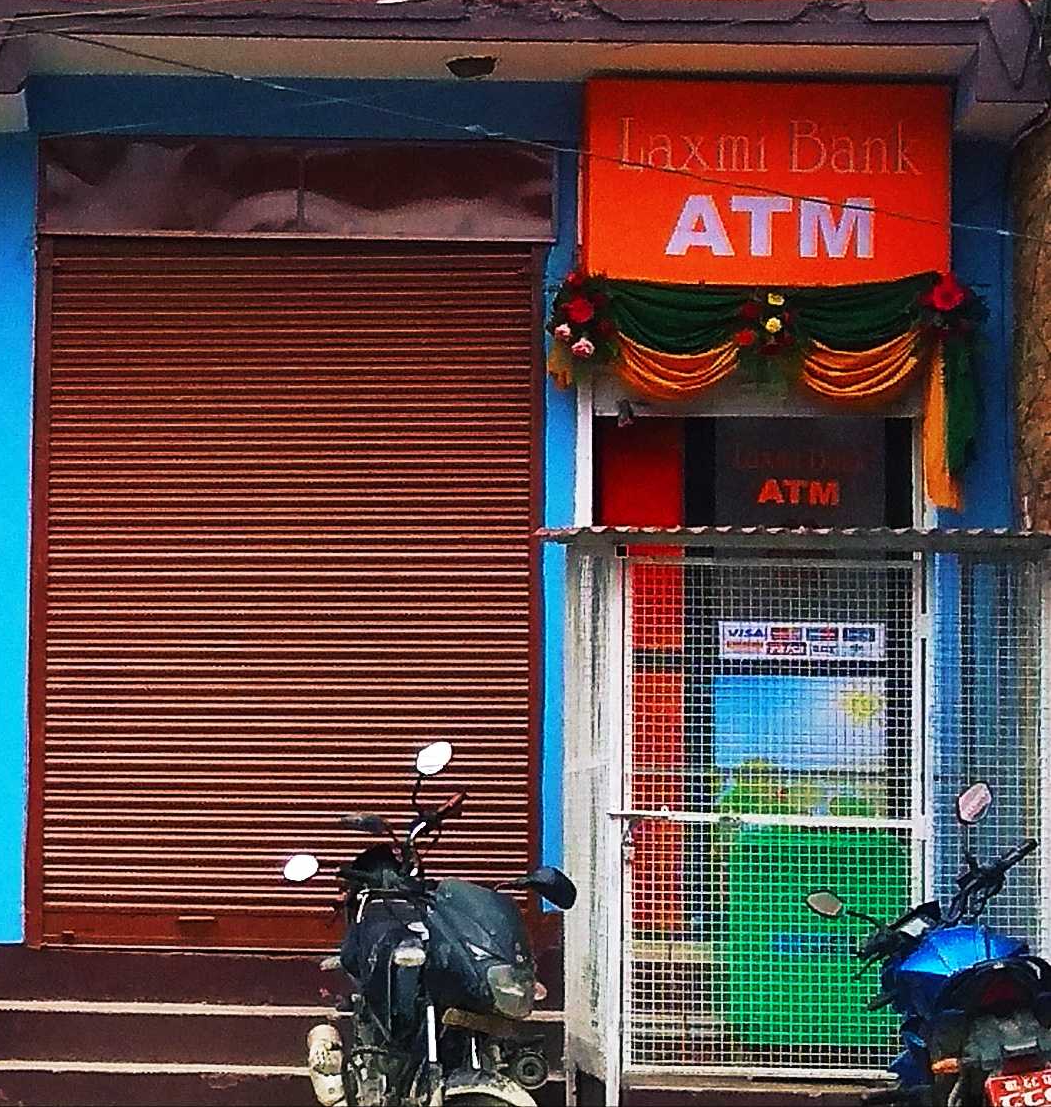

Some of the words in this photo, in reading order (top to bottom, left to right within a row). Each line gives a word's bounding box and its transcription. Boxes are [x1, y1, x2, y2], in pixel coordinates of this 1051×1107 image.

[618, 117, 769, 173] Laxmi
[787, 119, 923, 176] Bank
[664, 194, 875, 259] ATM
[757, 478, 841, 508] ATM
[727, 627, 767, 639] VISA
